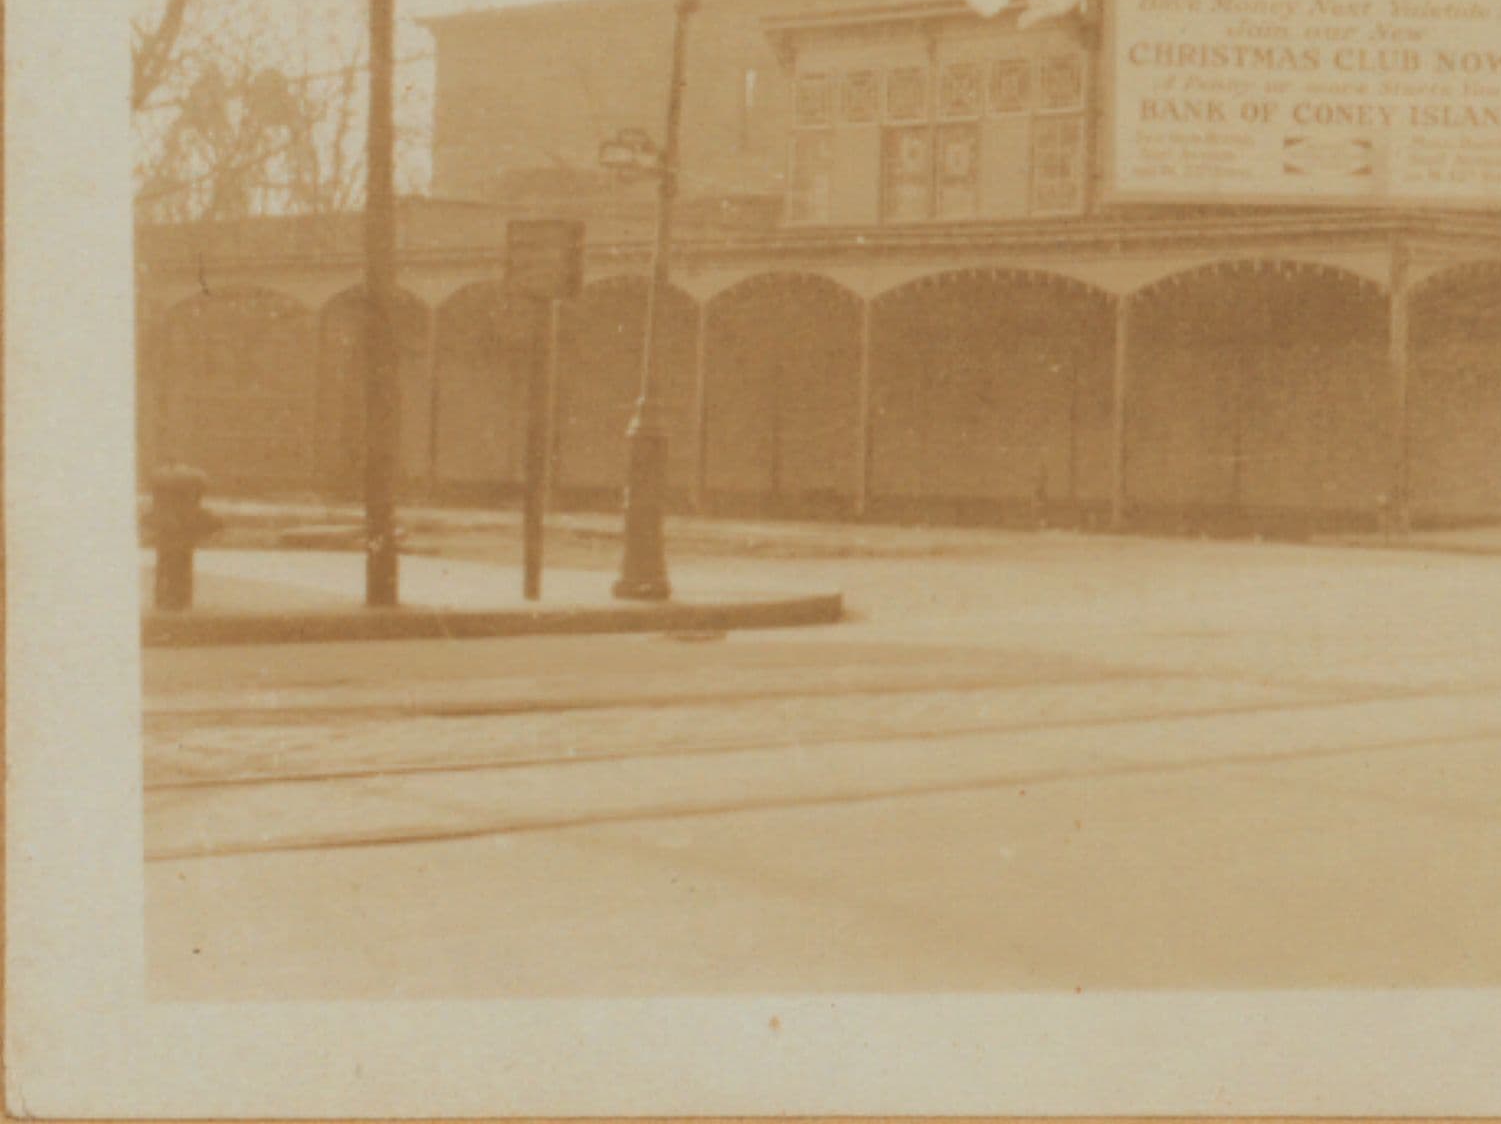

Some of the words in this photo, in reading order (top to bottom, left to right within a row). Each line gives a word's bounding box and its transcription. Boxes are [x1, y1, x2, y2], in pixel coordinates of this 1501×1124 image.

[1304, 26, 1359, 42] our
[1367, 22, 1427, 43] New
[1127, 41, 1321, 72] CHRISTMAS
[1333, 48, 1421, 75] CLUB
[1305, 81, 1367, 95] more
[1138, 98, 1227, 124] BANK
[1240, 102, 1280, 125] OF
[1292, 102, 1396, 127] CONEY
